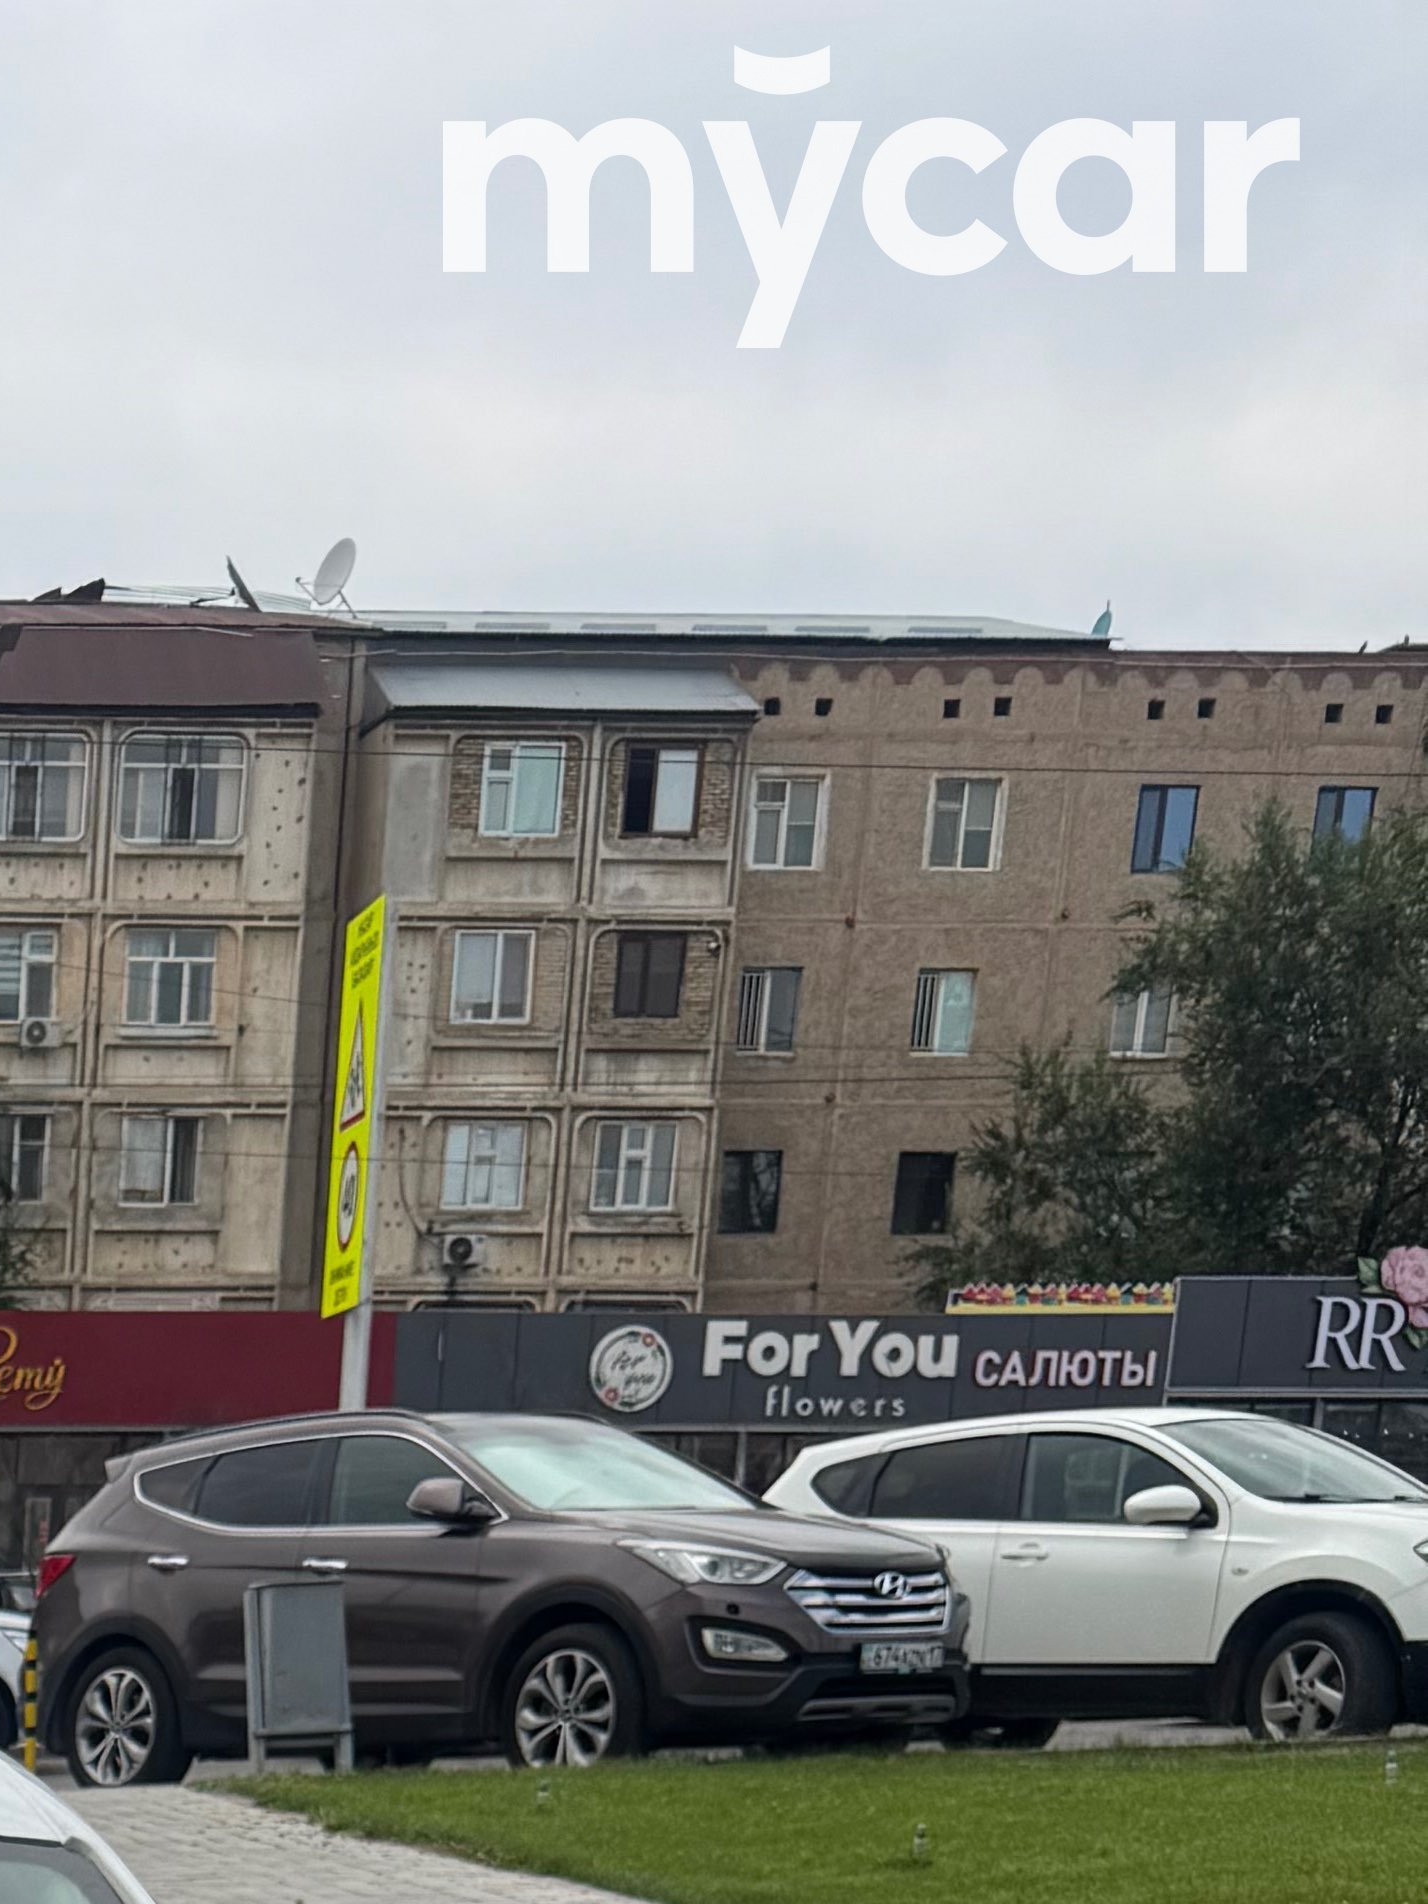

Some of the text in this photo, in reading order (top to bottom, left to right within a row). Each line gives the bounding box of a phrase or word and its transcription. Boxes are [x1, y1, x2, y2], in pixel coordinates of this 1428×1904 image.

[703, 1320, 959, 1378] For You
[1305, 1296, 1406, 1371] RR
[974, 1349, 1157, 1387] САЛЮТЫ
[765, 1384, 906, 1417] flowers
